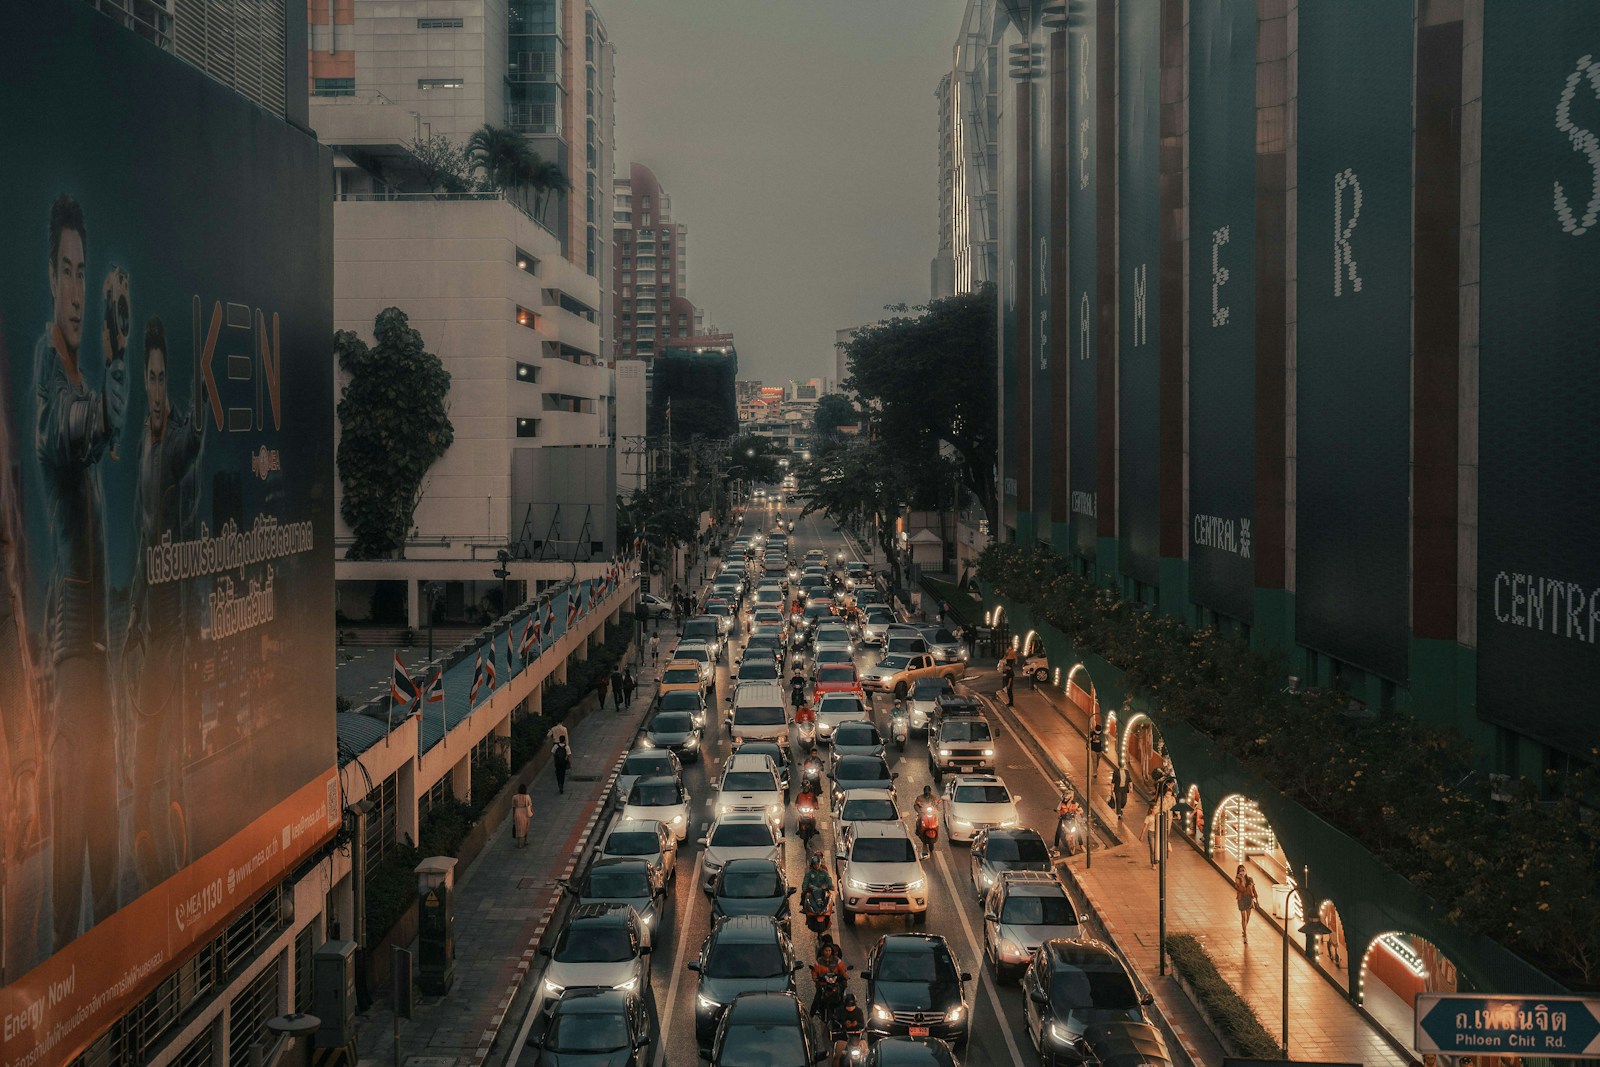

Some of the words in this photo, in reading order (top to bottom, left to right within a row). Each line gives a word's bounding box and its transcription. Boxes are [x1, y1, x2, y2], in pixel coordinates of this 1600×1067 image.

[192, 294, 281, 432] KEN
[1194, 513, 1238, 553] CENTRAL
[235, 833, 279, 885] www.mea.or.th
[186, 892, 202, 918] MEA
[202, 878, 223, 915] 1130
[4, 994, 46, 1043] Energy
[1455, 1034, 1501, 1046] Phloen
[1508, 1034, 1536, 1047] Chit
[1545, 1035, 1566, 1048] Rd.
